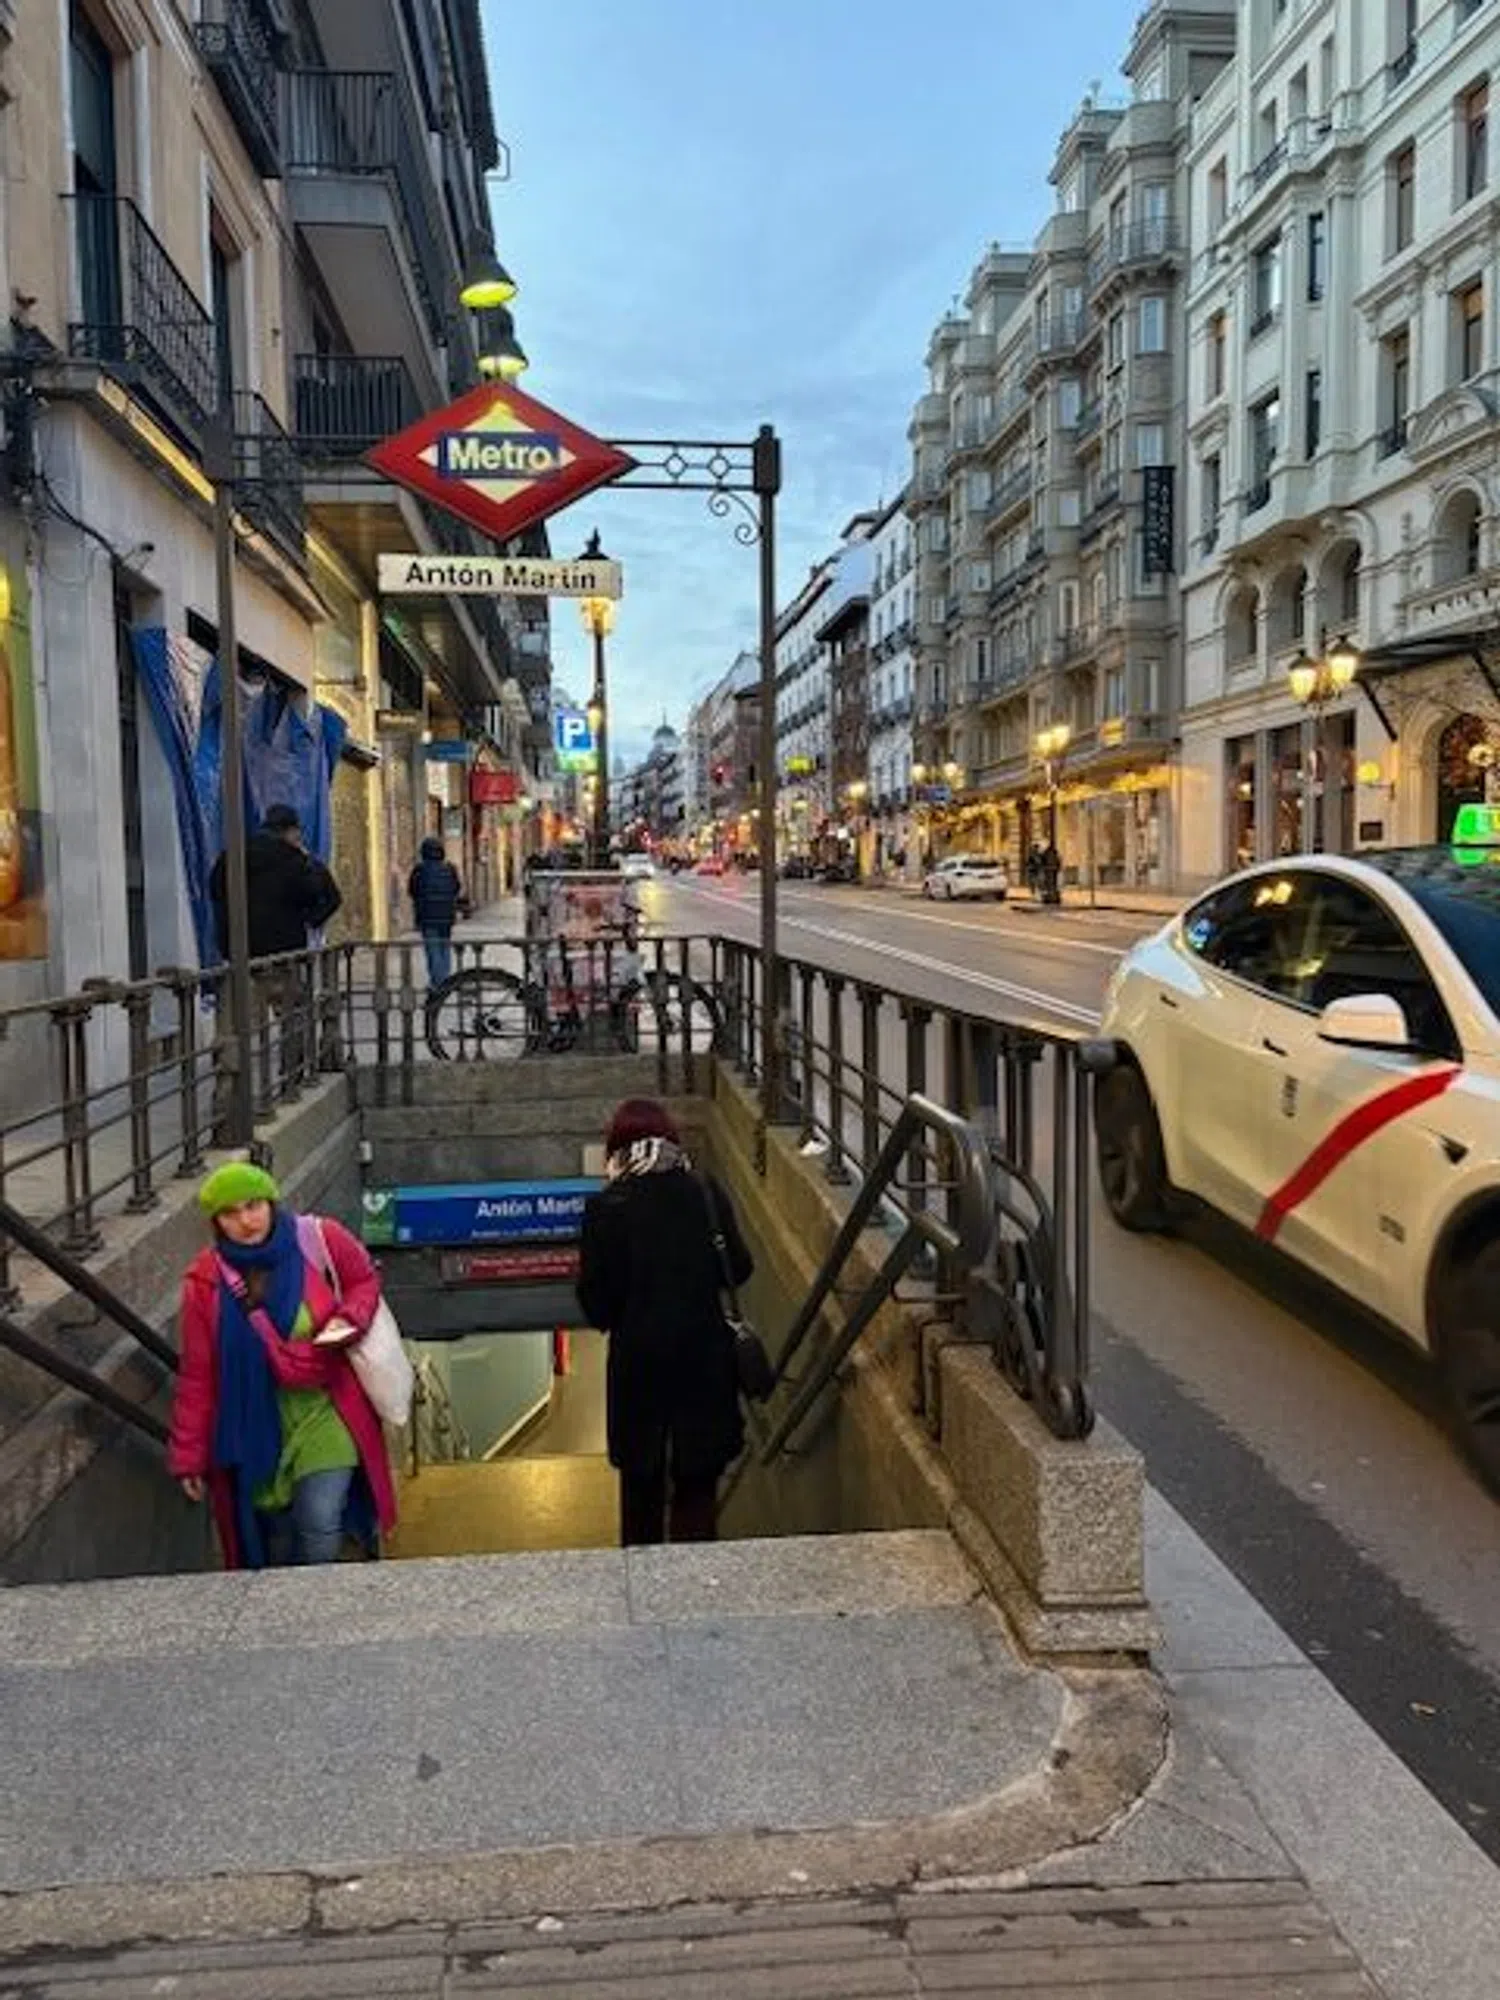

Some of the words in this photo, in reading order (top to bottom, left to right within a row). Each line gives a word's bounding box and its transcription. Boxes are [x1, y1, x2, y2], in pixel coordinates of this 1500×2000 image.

[449, 437, 552, 471] Metro
[405, 560, 493, 587] Antón
[503, 565, 596, 590] Martín
[562, 717, 587, 749] P
